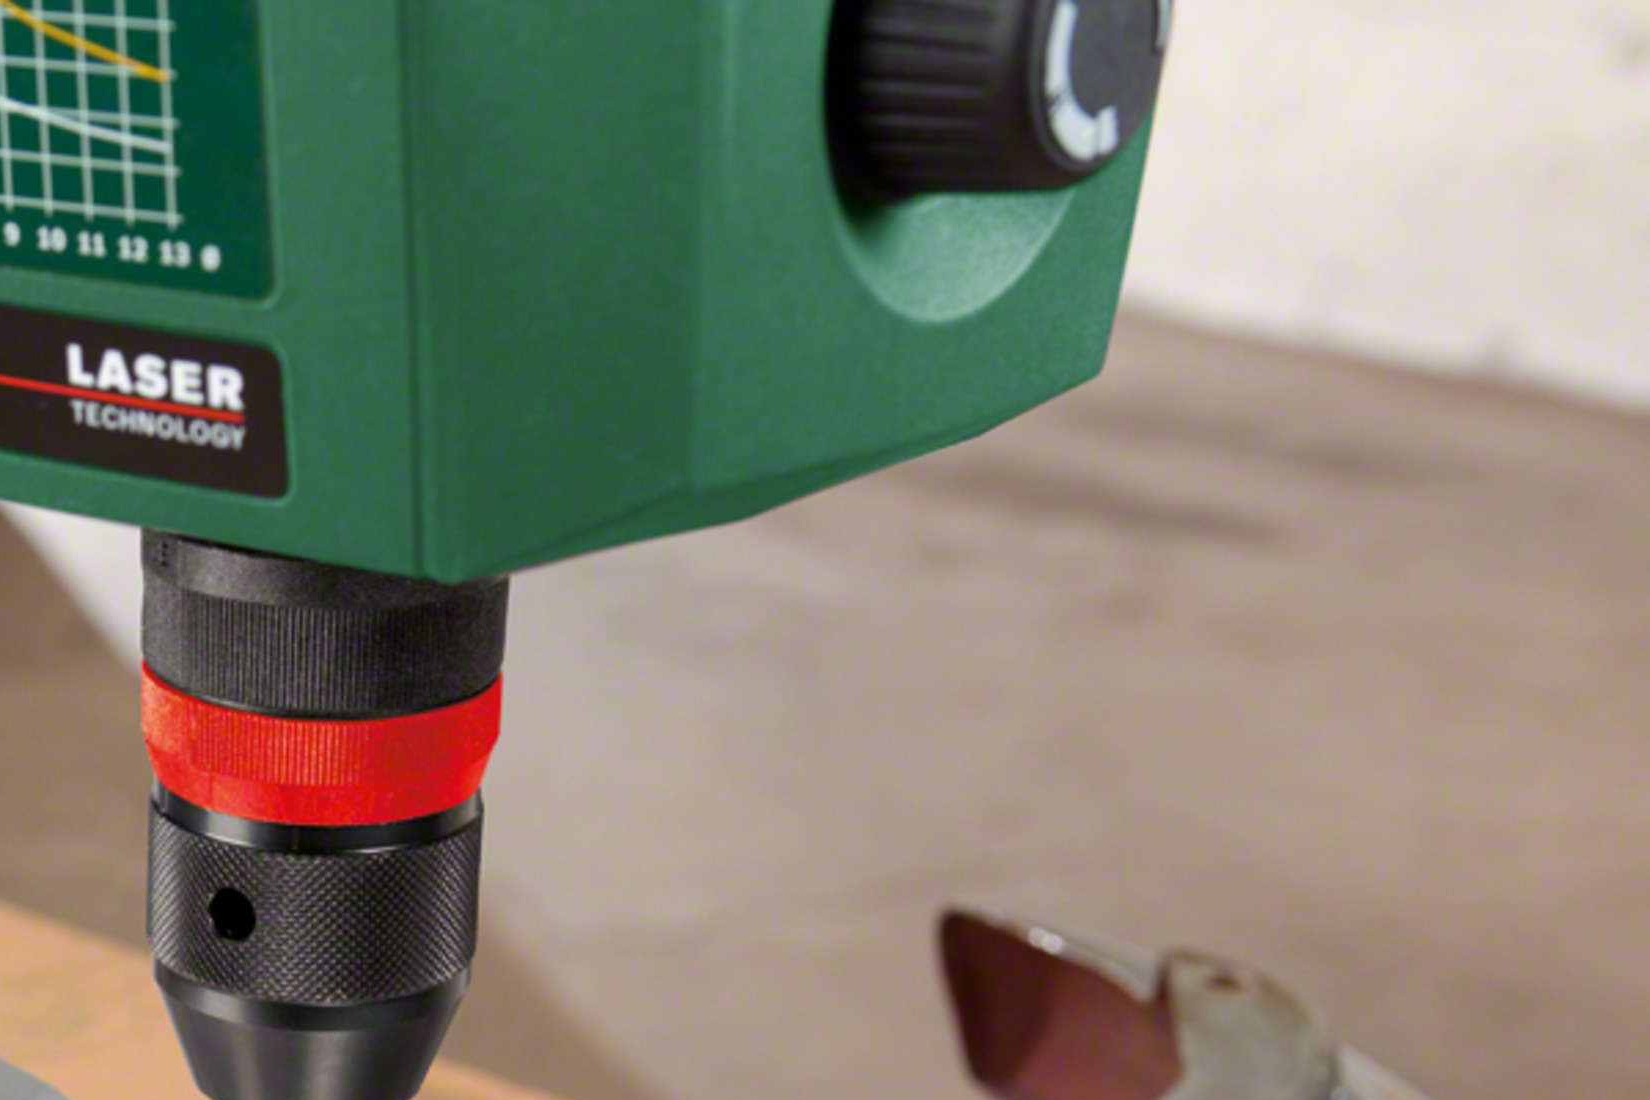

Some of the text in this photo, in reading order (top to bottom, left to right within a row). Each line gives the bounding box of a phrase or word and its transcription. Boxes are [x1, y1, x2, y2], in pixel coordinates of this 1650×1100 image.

[3, 221, 21, 247] 9
[37, 225, 68, 253] 10
[77, 230, 106, 258] 11
[118, 235, 149, 263] 12
[159, 239, 191, 268] 13
[66, 343, 244, 412] LASER
[69, 399, 246, 451] TECHNOLOGY
